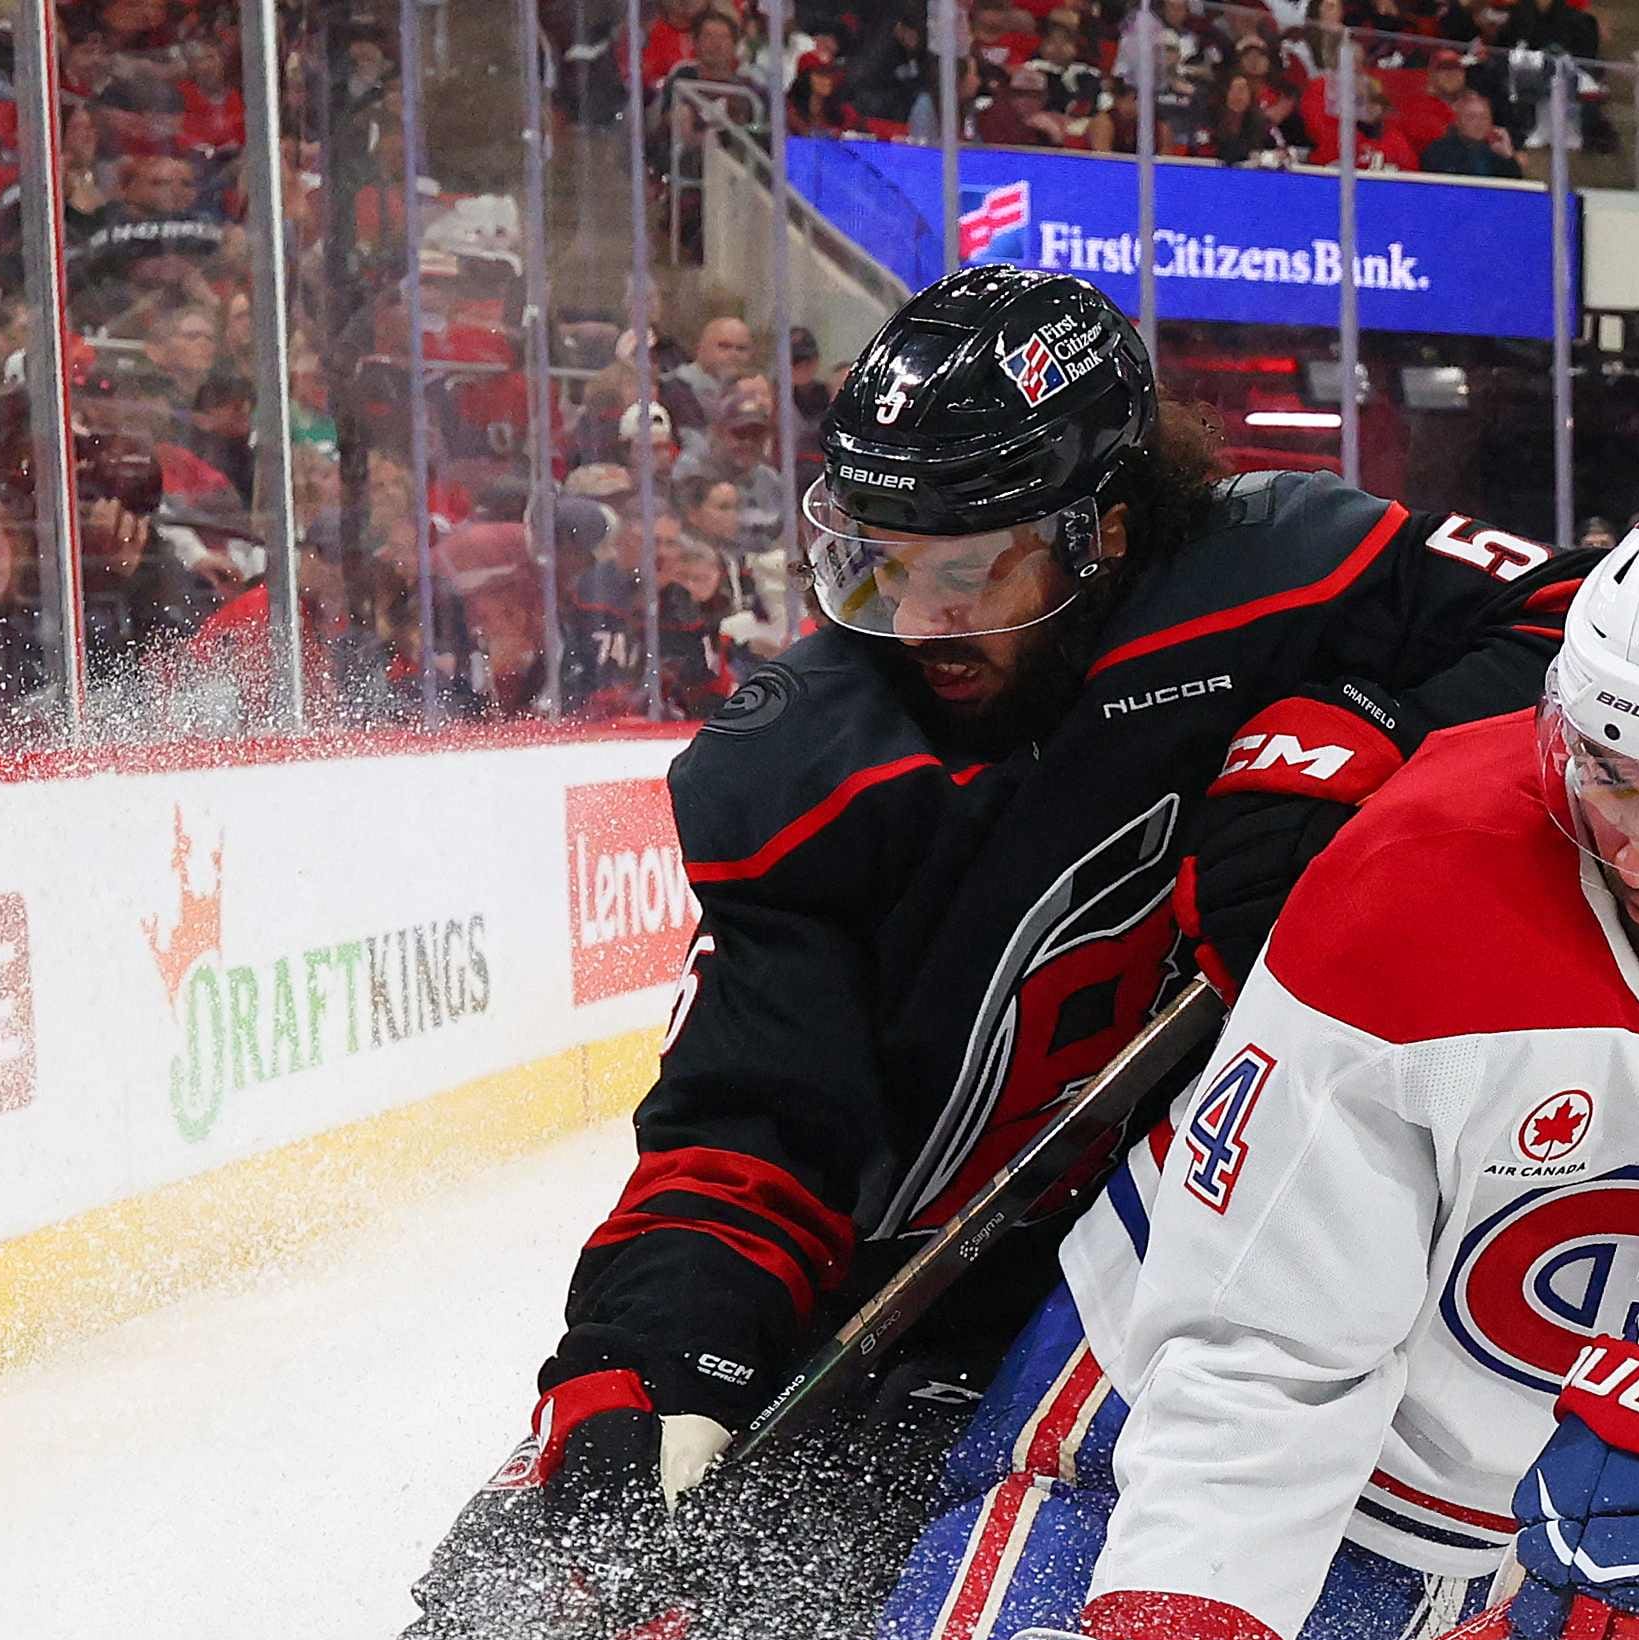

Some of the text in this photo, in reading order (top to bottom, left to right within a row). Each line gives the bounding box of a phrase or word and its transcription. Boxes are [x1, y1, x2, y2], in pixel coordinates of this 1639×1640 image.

[1039, 313, 1078, 344] First
[1054, 321, 1102, 360] Citizens
[1064, 348, 1103, 382] Bank
[839, 464, 916, 491] BAUER
[1424, 511, 1555, 583] 5
[1103, 674, 1234, 719] NUCOR
[1342, 683, 1396, 731] CHATFIELD
[1218, 734, 1356, 780] CM
[574, 830, 703, 950] Lenov
[169, 912, 490, 1143] DRAFTKINGS
[1483, 1161, 1587, 1177] AIR CANADA
[971, 1211, 1005, 1247] sigma
[698, 1353, 754, 1380] CCM
[749, 1374, 806, 1431] CHATFIELD
